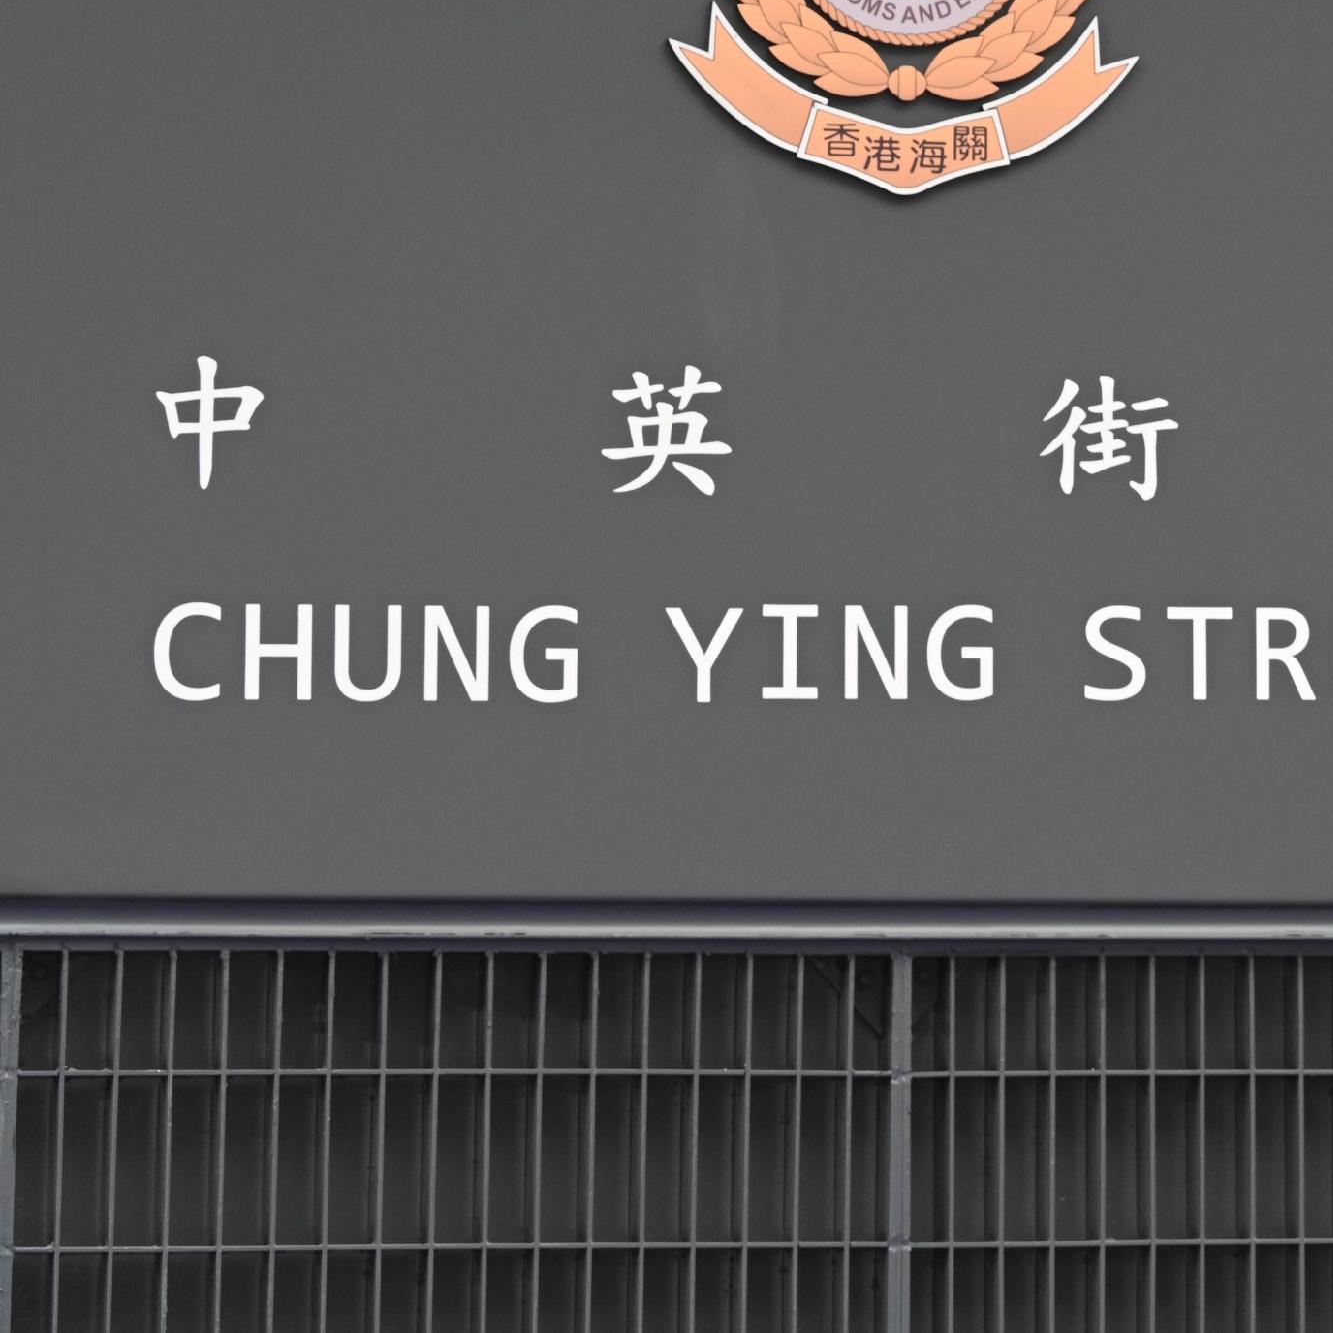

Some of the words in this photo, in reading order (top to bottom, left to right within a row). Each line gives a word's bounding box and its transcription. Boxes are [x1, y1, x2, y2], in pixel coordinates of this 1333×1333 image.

[901, 0, 952, 24] AND
[823, 123, 988, 174] 香港海關
[153, 601, 579, 703] CHUNG
[665, 603, 994, 703] YING
